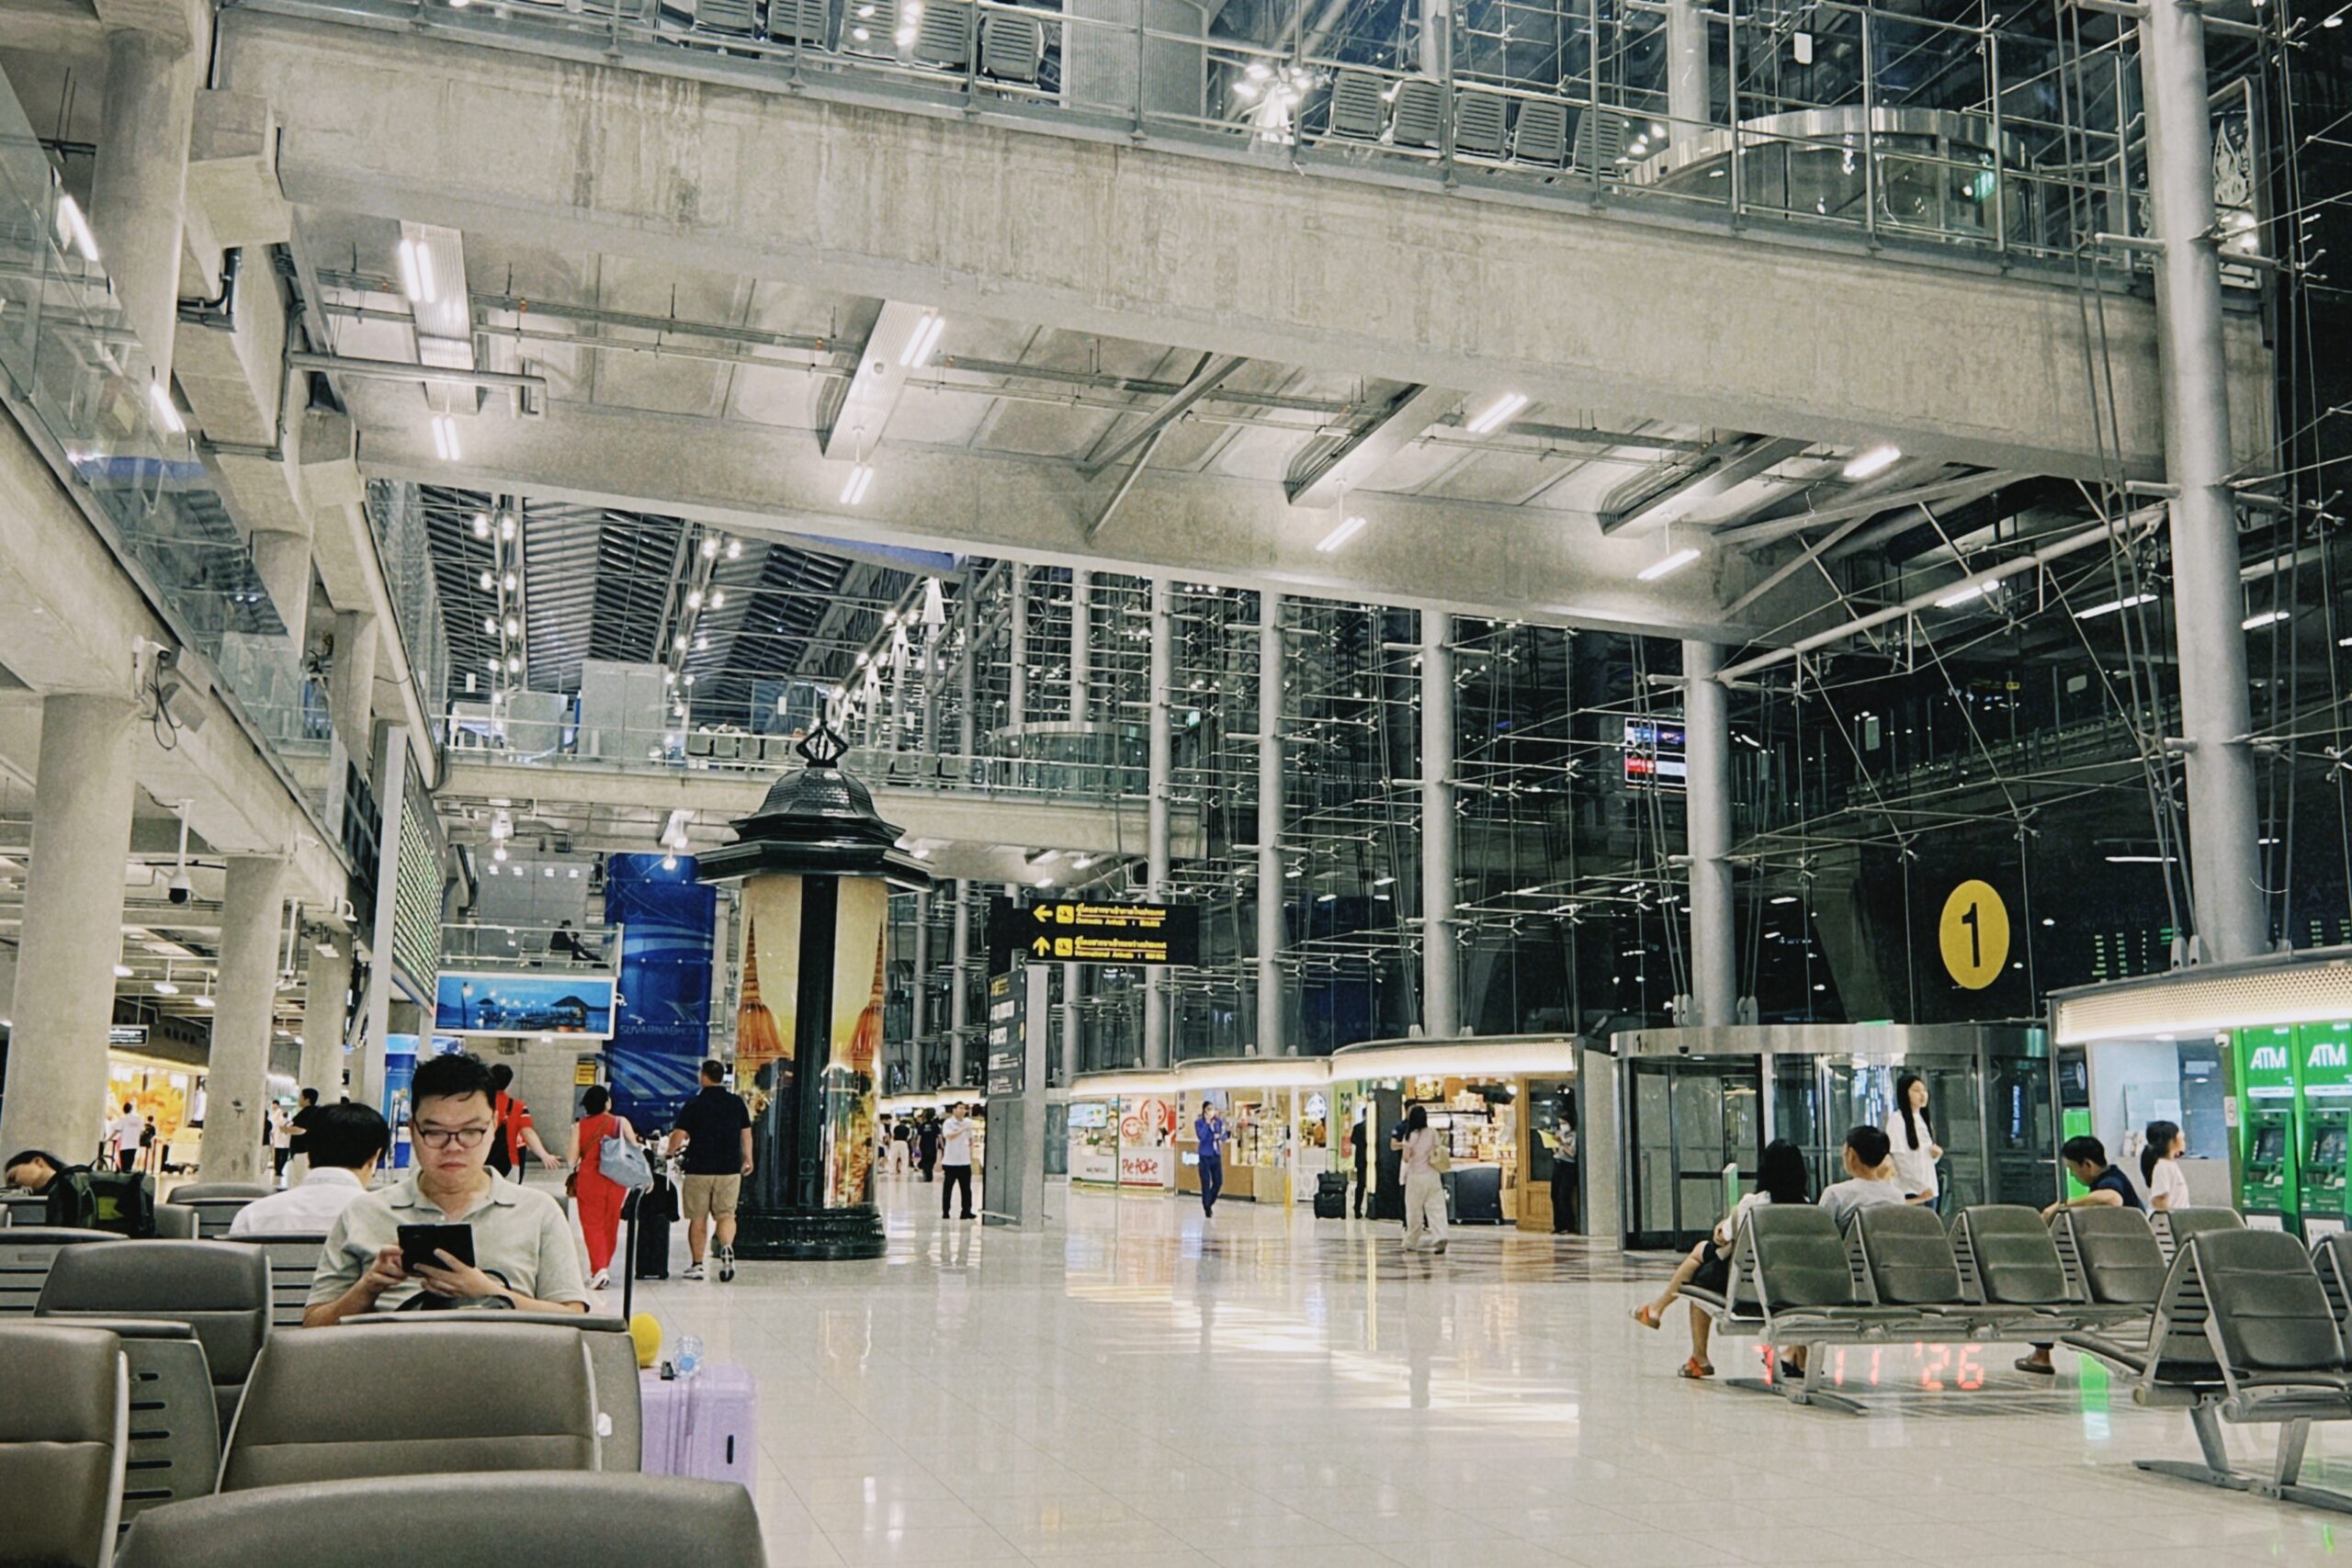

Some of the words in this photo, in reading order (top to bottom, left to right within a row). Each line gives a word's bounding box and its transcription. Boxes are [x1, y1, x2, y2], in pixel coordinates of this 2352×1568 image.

[1962, 902, 1981, 967] 1
[2250, 1046, 2287, 1069] ATM
[2307, 1043, 2347, 1067] ATM
